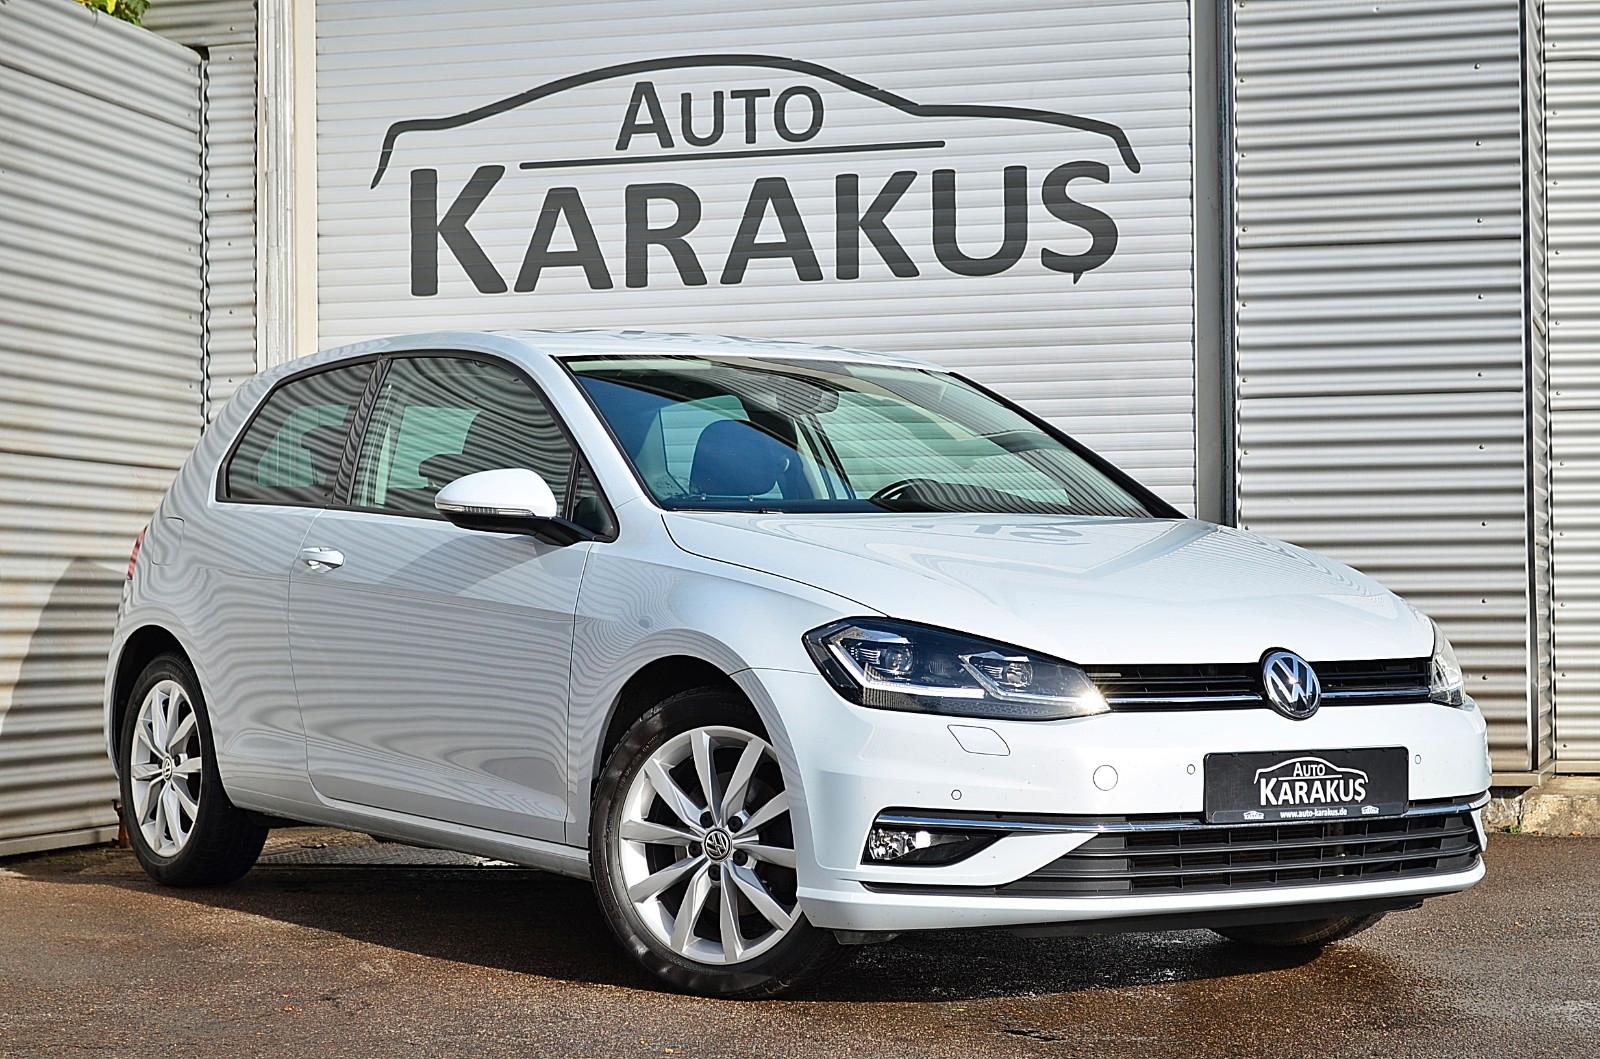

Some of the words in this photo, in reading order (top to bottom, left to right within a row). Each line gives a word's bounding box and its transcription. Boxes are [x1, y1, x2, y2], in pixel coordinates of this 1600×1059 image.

[615, 81, 825, 151] AUTO
[1293, 762, 1325, 777] AUTO
[1279, 806, 1348, 819] www.auto-karakus.de
